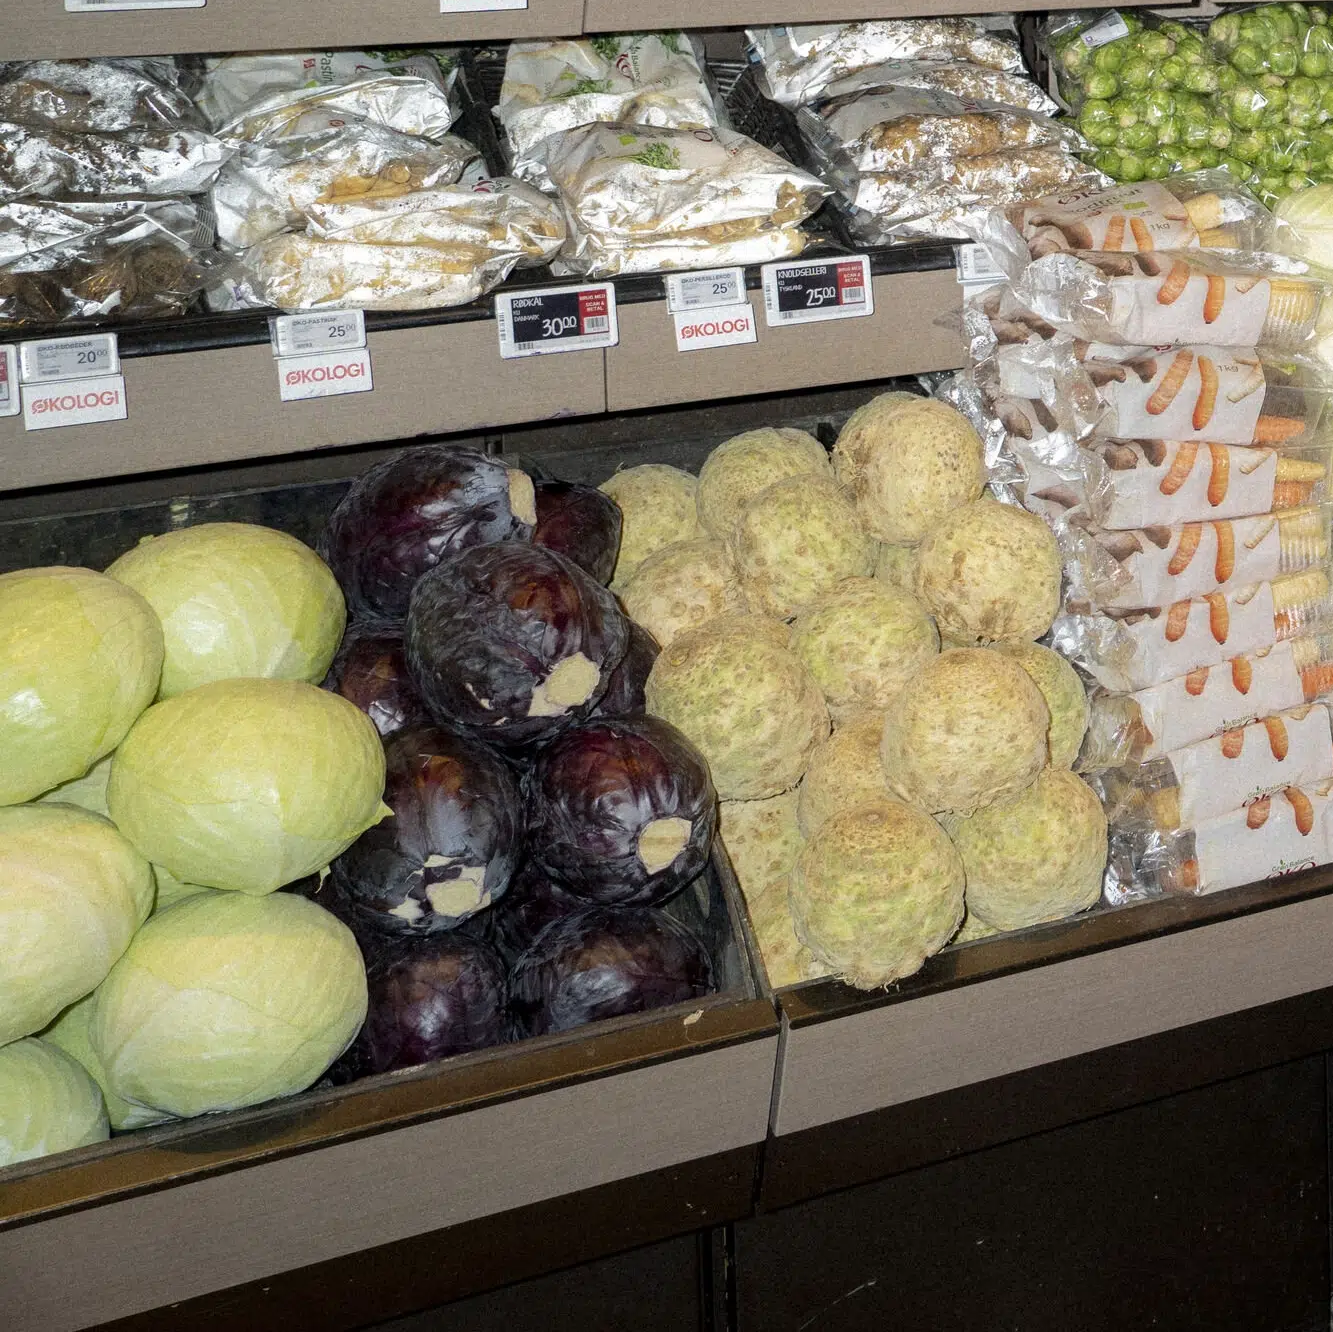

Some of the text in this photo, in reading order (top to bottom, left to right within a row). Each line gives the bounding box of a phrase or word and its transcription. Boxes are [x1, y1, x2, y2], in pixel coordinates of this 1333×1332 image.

[777, 266, 827, 279] KNOLDSELLERI
[512, 297, 543, 308] RØDKÅL
[681, 318, 749, 339] ØKOLOGI
[285, 363, 365, 385] ØKOLOGI
[31, 390, 119, 415] ØKOLOGI
